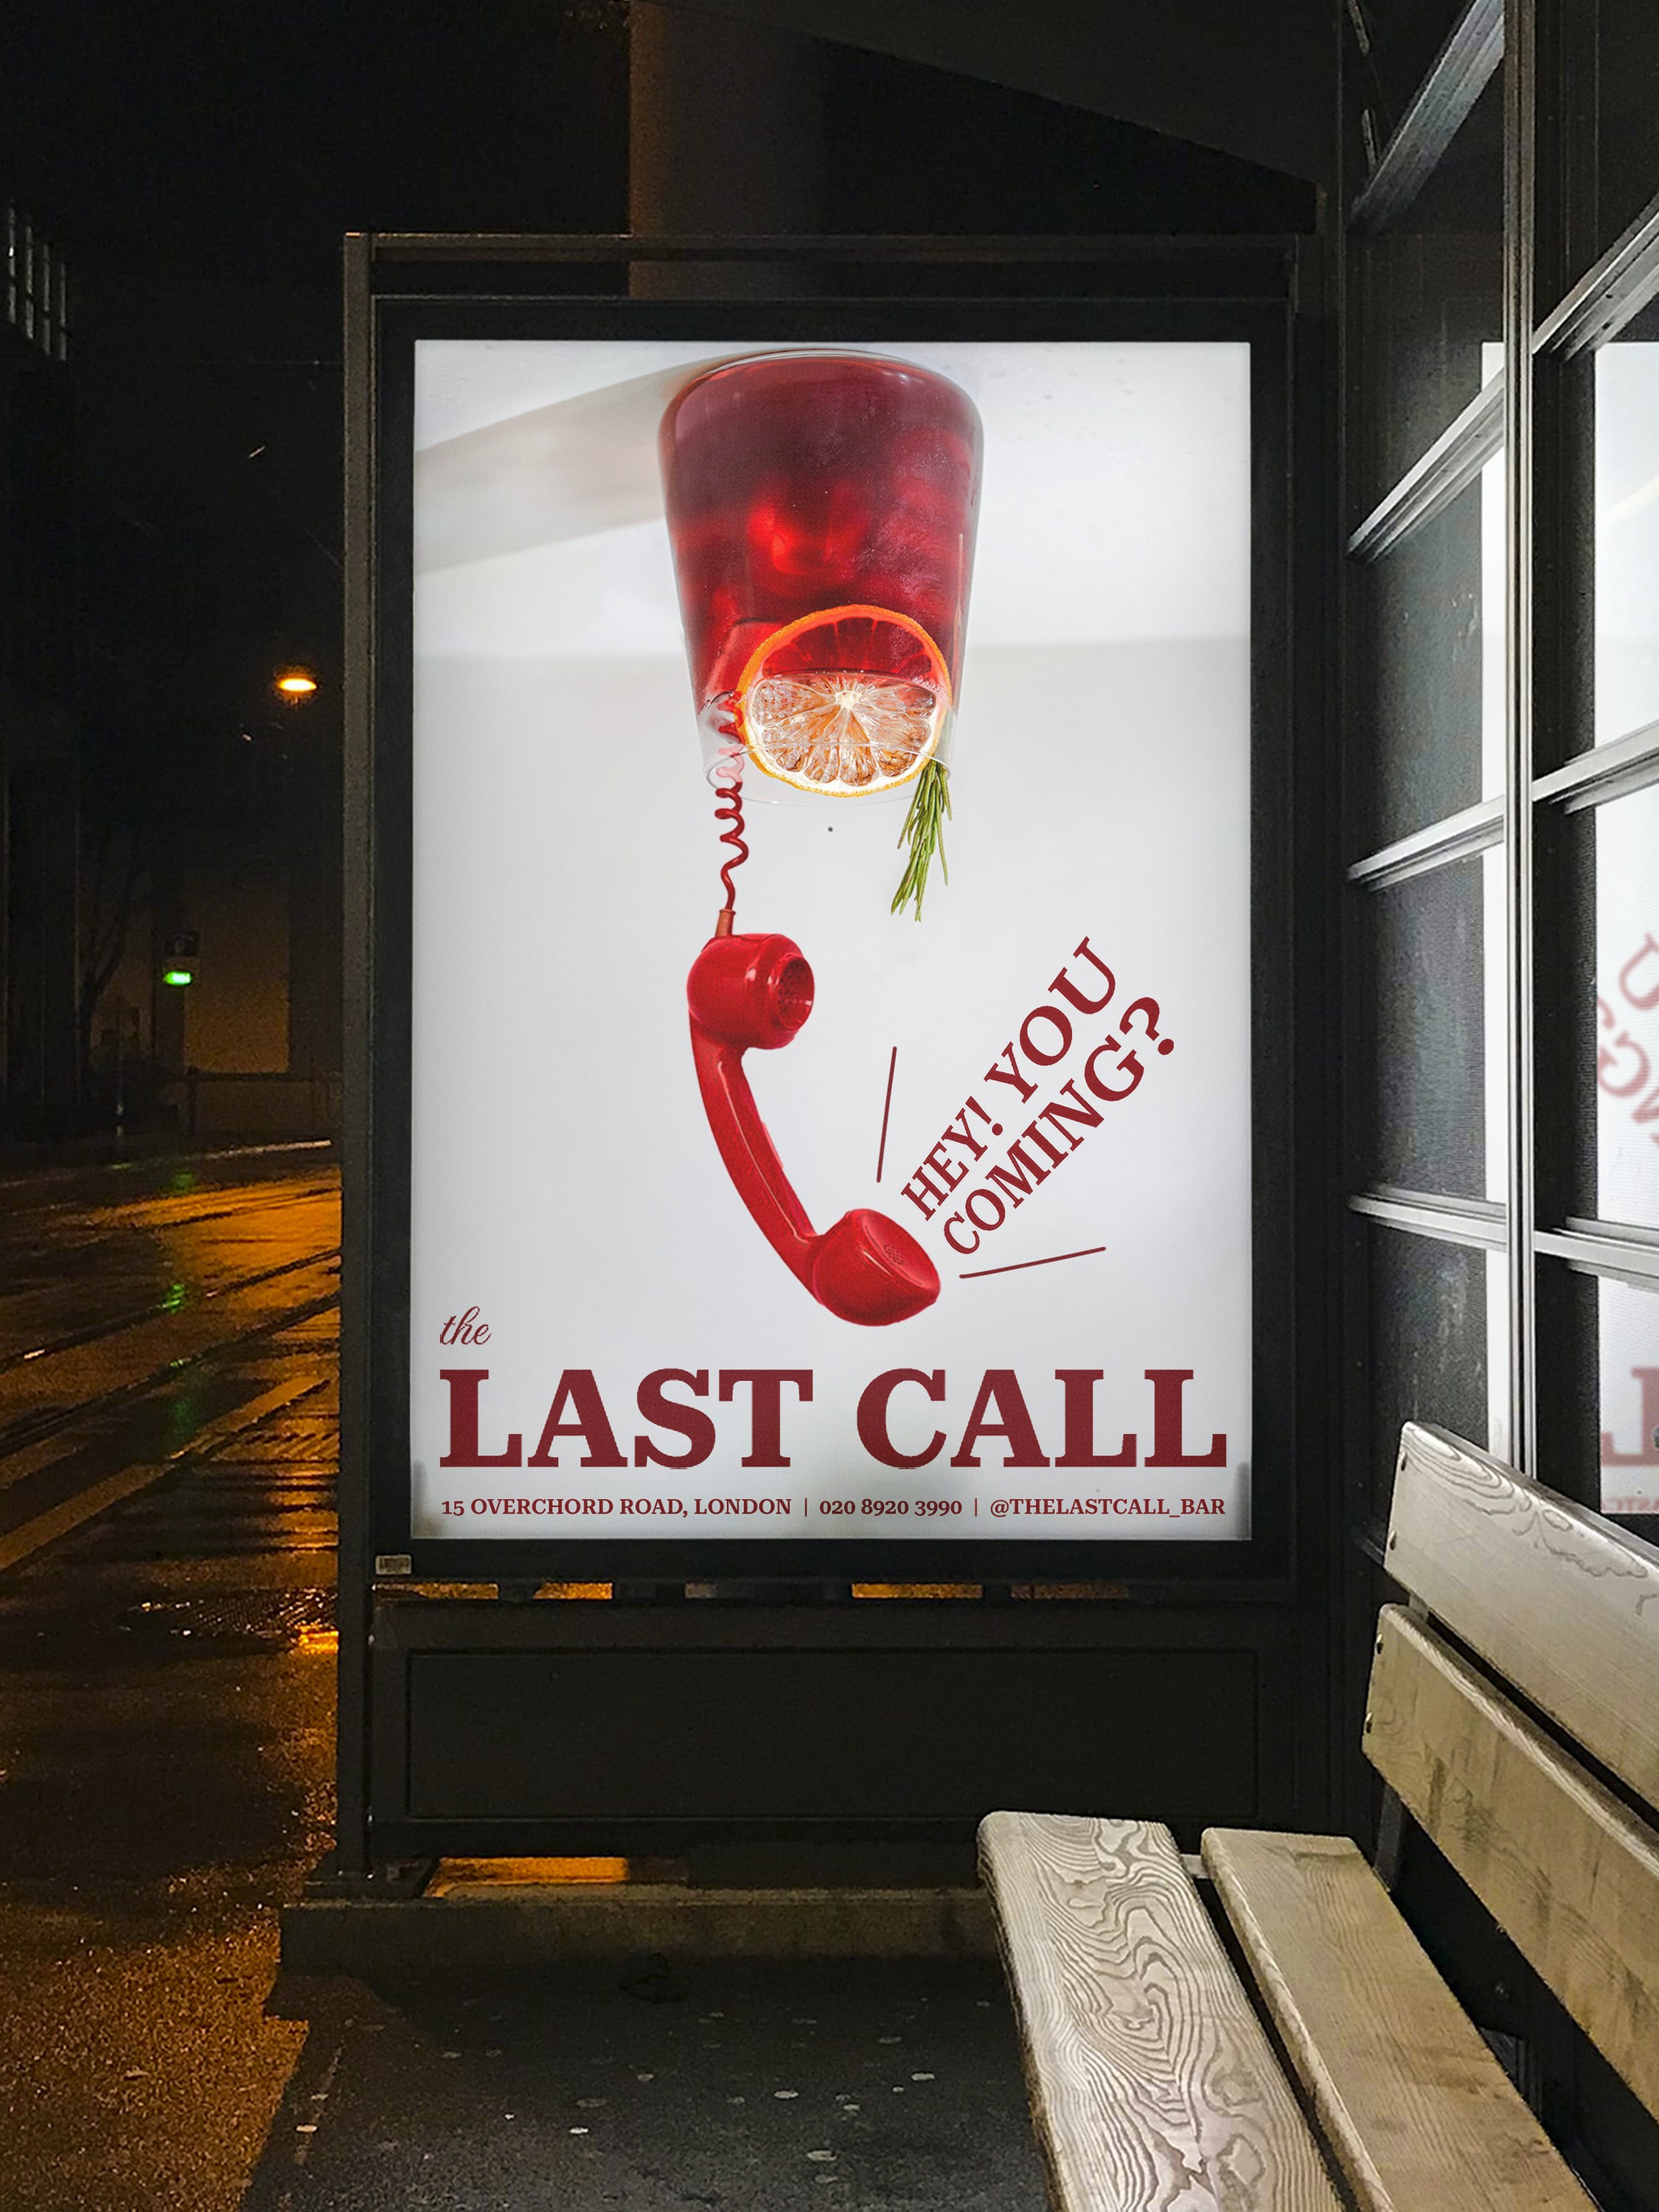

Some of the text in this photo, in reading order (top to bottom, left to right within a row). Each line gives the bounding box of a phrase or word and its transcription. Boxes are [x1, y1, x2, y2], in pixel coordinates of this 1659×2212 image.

[900, 936, 1116, 1222] HEY! YOU
[943, 996, 1175, 1255] COMING?
[439, 1306, 492, 1346] the
[439, 1368, 1227, 1470] LAST CALL
[442, 1500, 465, 1517] 15
[470, 1498, 614, 1516] OVERCHORD
[619, 1498, 688, 1518] ROAD,
[695, 1498, 792, 1515] LONDON
[819, 1500, 856, 1515] 020
[860, 1498, 909, 1517] 8920
[914, 1500, 963, 1517] 3990
[990, 1498, 1225, 1518] @THELASTCALL_BAR
